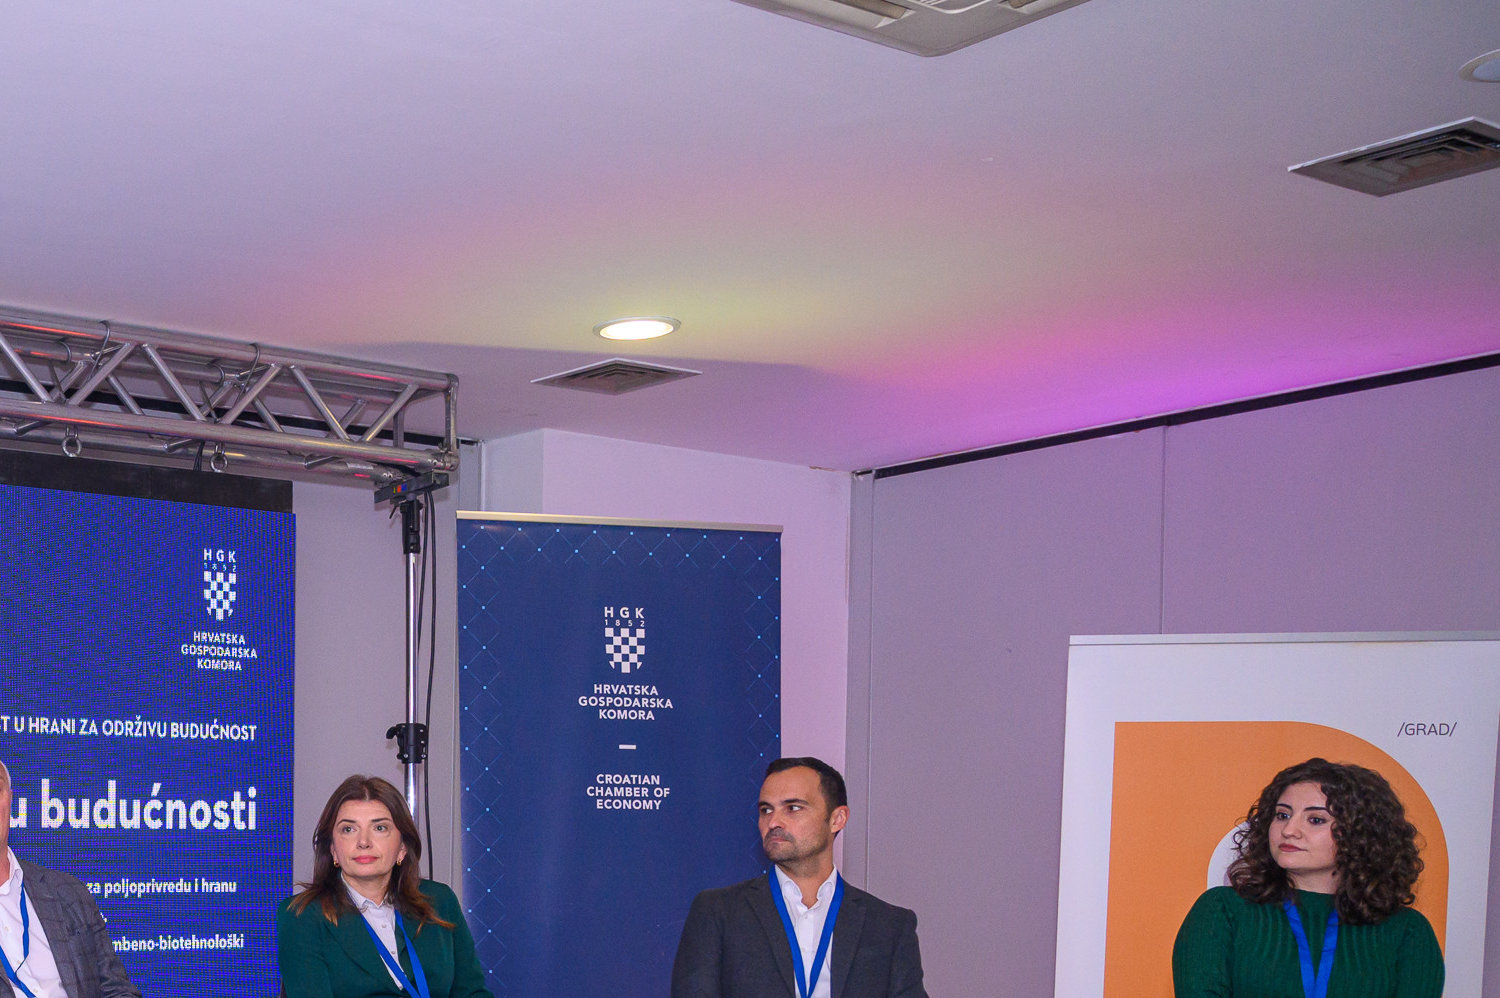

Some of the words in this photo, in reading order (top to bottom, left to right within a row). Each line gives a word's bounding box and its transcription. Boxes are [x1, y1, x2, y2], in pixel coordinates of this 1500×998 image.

[193, 631, 246, 645] HRVATSKA
[181, 644, 257, 659] GOSPODARSKA
[197, 658, 242, 671] KOMORA
[593, 684, 658, 696] HRVATSKA
[578, 696, 673, 709] GOSPODARSKA
[599, 709, 655, 721] KOMORA
[14, 716, 25, 733] U
[29, 717, 76, 735] HRANI
[79, 719, 98, 736] ZA
[102, 715, 167, 738] ODRŽIVU
[170, 718, 257, 741] BUDUĆNOST
[596, 774, 660, 785] CROATIAN
[587, 786, 649, 797] CHAMBER
[653, 787, 670, 798] OF
[41, 778, 257, 830] budućnosti
[596, 799, 662, 810] ECONOMY
[104, 878, 191, 898] poljoprivredu
[194, 878, 198, 893] i
[201, 878, 237, 893] hranu
